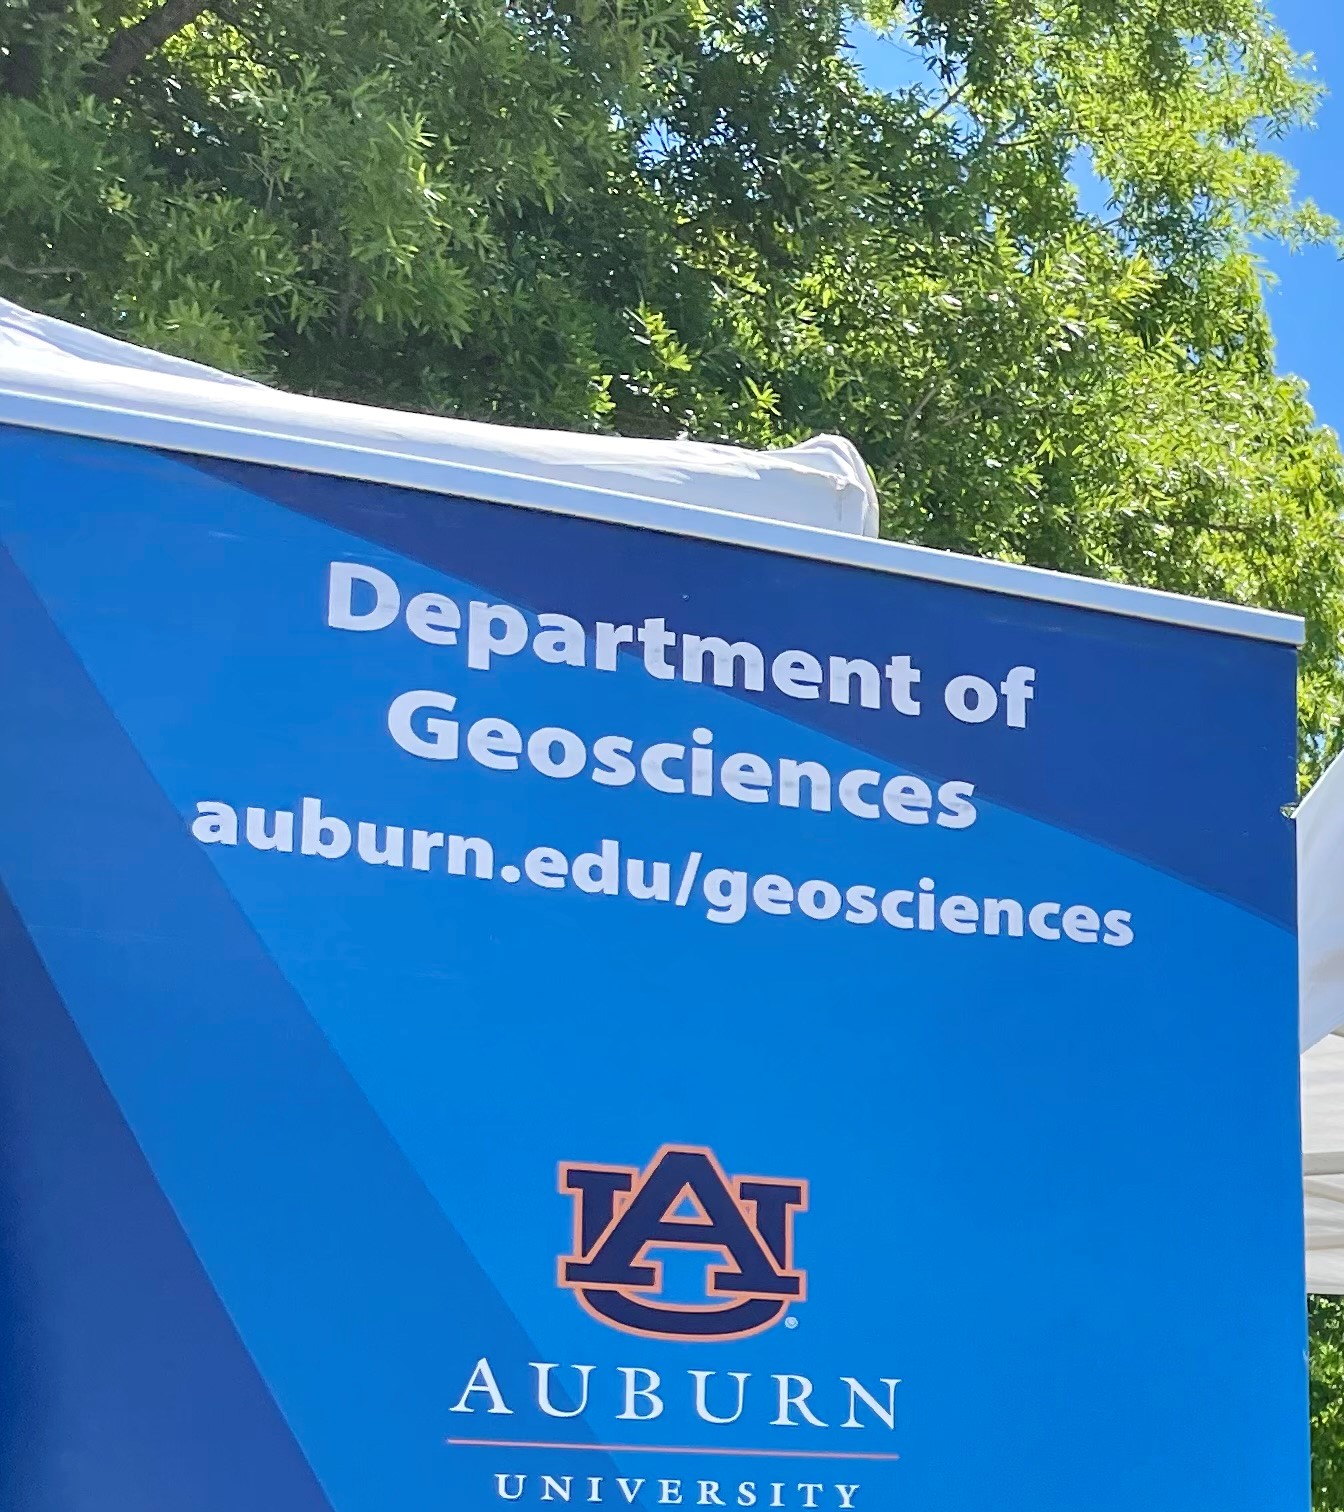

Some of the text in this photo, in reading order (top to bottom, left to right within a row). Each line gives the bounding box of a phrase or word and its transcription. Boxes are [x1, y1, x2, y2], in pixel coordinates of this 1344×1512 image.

[327, 560, 1035, 728] Department of
[387, 688, 978, 829] Geosciences
[191, 797, 1134, 948] auburn.edu/geosciences
[449, 1357, 901, 1430] AUBURN
[495, 1474, 859, 1508] UNIVERSITY
